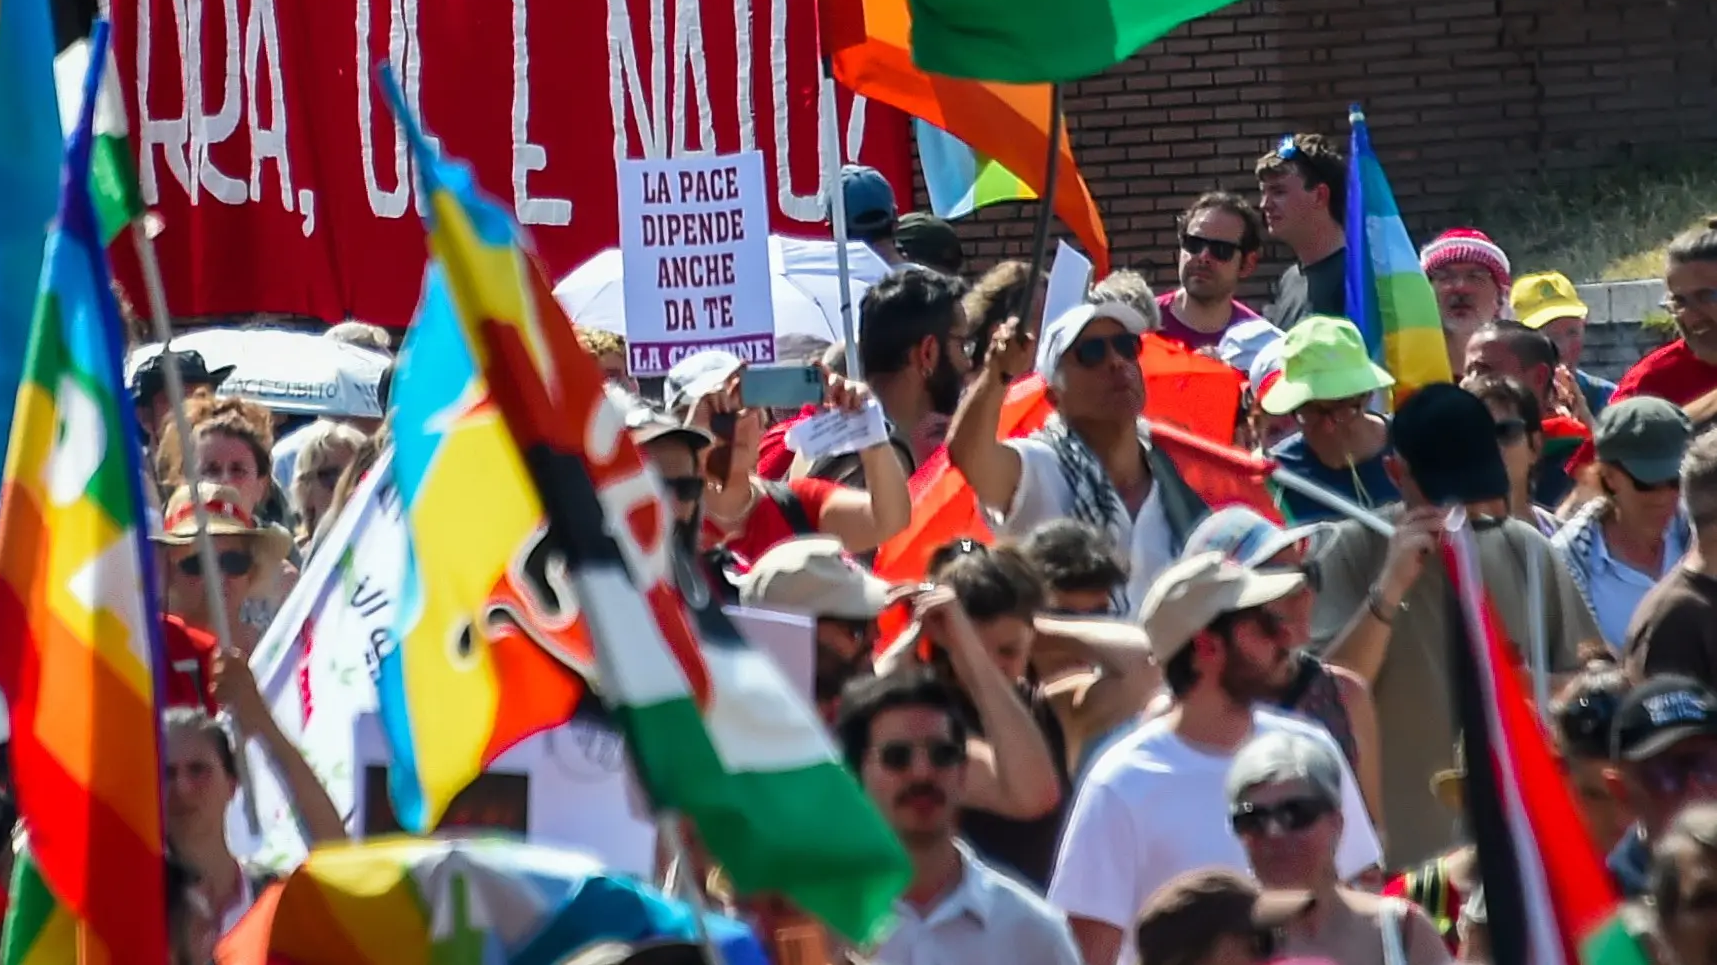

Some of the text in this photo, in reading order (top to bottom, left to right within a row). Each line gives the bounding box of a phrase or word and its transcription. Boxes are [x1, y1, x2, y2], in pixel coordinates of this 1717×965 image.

[642, 166, 739, 204] LA PACE
[641, 209, 745, 247] DIPENDE
[657, 253, 735, 288] ANCHE
[664, 295, 734, 332] DA TE
[633, 345, 664, 370] LA
